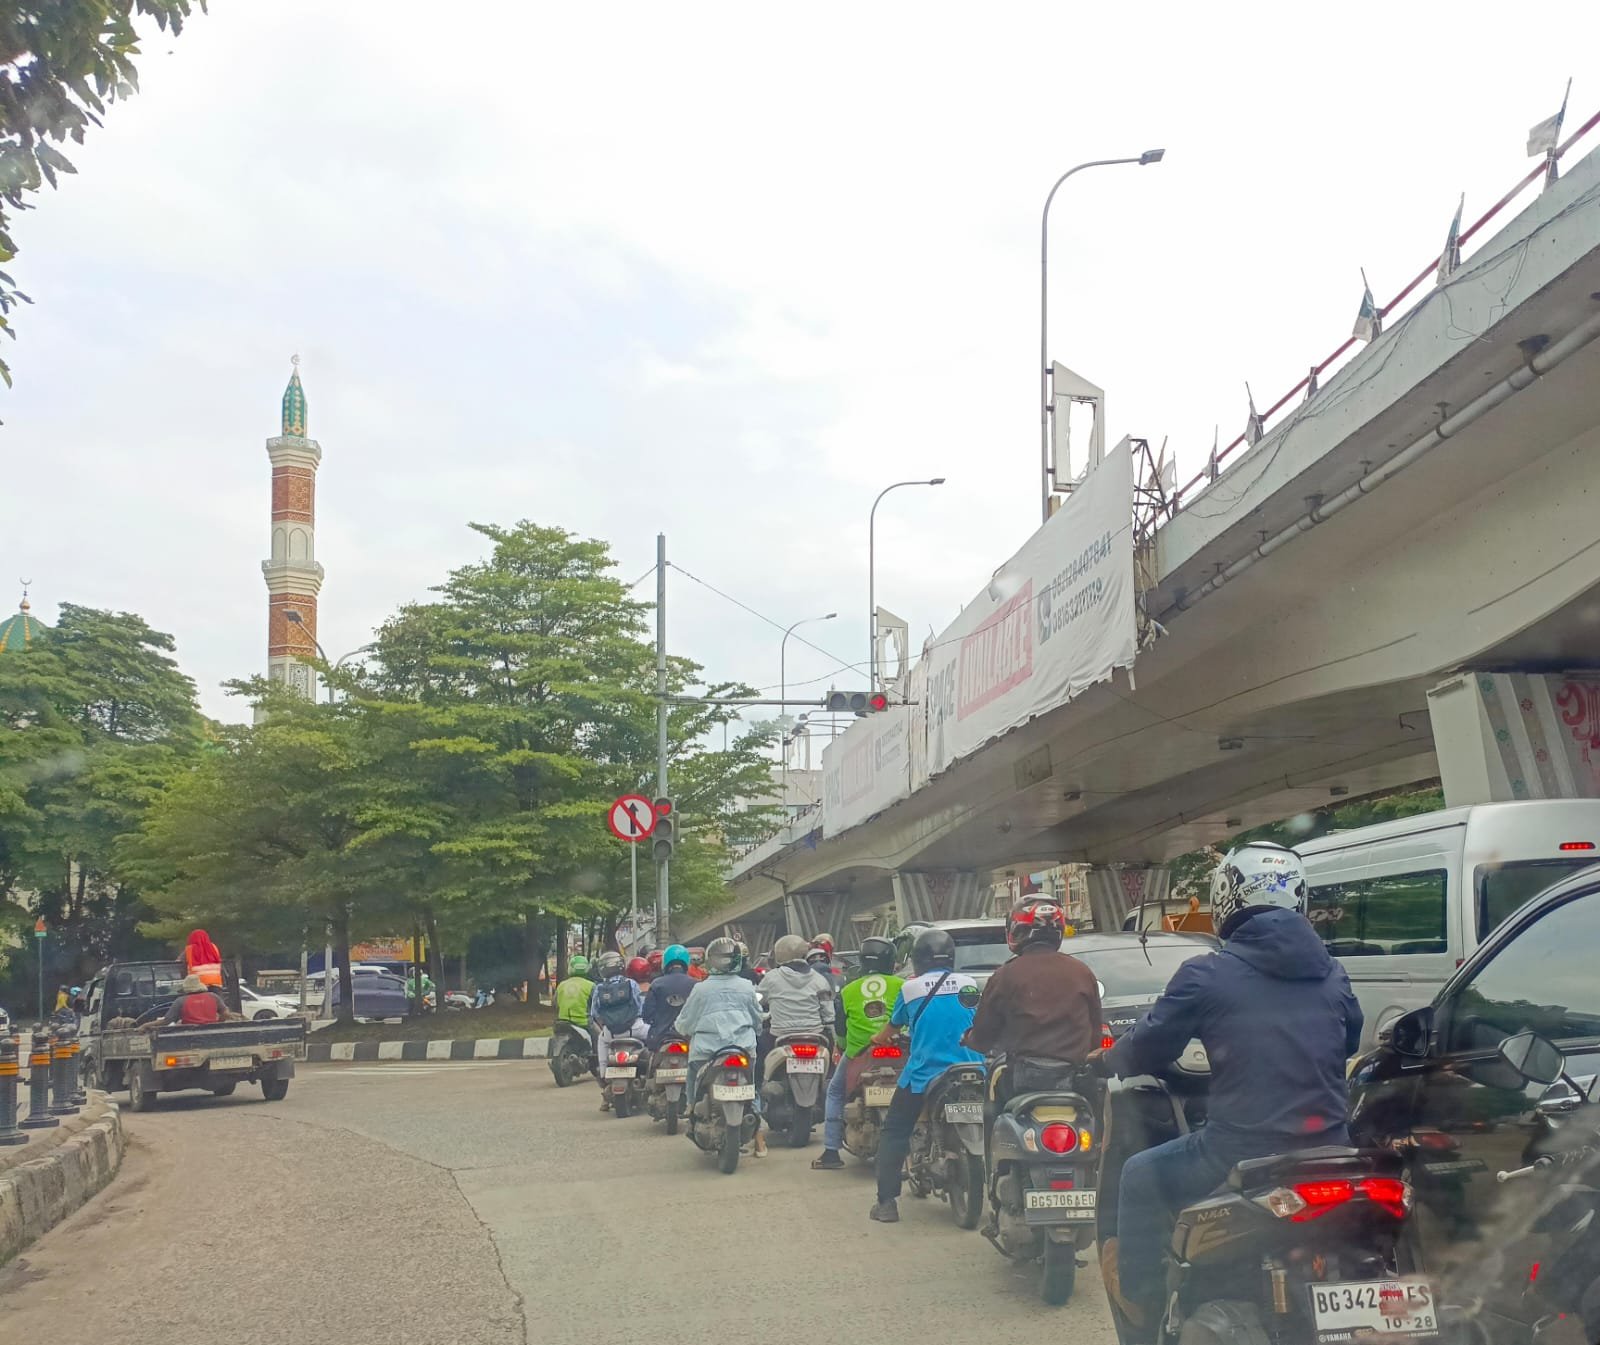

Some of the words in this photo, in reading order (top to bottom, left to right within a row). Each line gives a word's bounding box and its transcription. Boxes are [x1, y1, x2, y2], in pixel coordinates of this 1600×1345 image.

[961, 599, 1028, 708] AVAILABLE
[1109, 1018, 1137, 1026] VIOS
[1316, 1291, 1340, 1314] BG
[1326, 1332, 1352, 1343] YAMAHA
